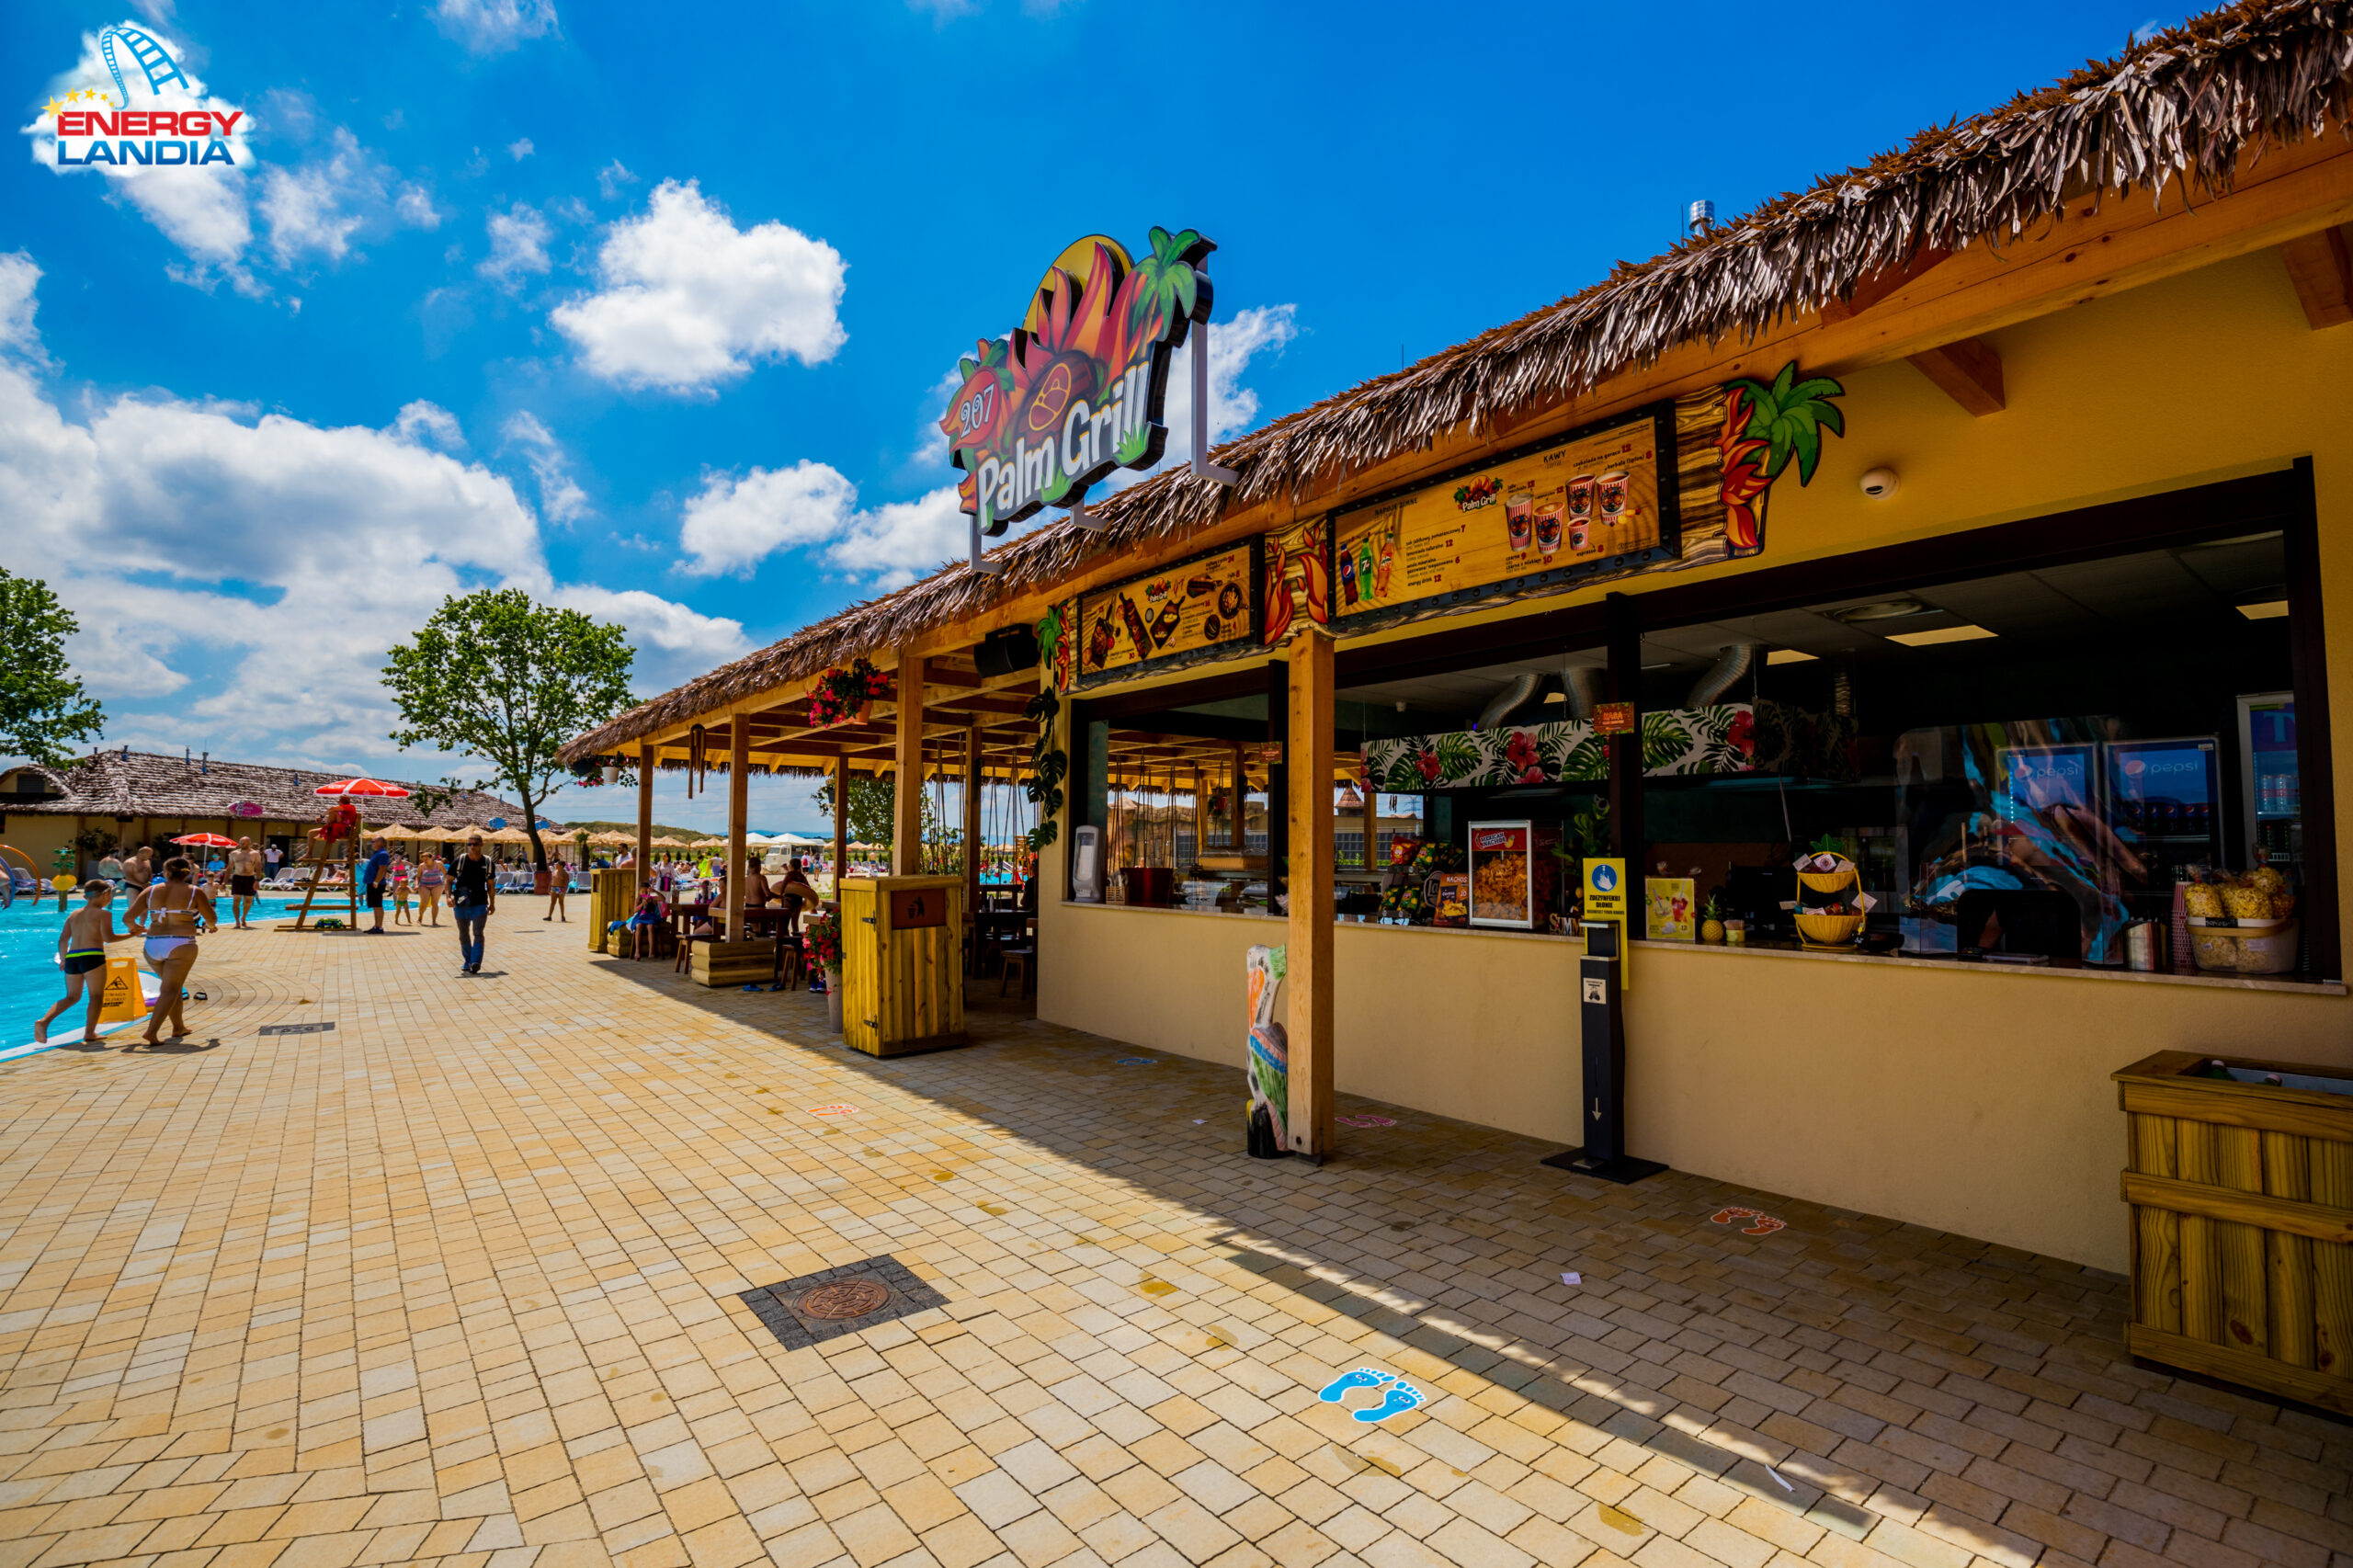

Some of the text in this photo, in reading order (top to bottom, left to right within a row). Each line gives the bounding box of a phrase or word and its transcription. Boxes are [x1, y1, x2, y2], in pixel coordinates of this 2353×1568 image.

[960, 382, 995, 437] 207
[976, 360, 1150, 529] Palm Grill
[1621, 443, 1631, 453] 12
[1543, 449, 1567, 464] KAWY
[1461, 492, 1496, 513] Palm Grill
[1446, 539, 1453, 548] 12
[1455, 555, 1461, 563] 6
[1521, 551, 1527, 560] 9
[1543, 555, 1553, 564] 10
[1434, 574, 1442, 583] 12
[2036, 766, 2079, 779] pepsi
[2151, 760, 2199, 776] pepsi
[1480, 832, 1504, 842] MEXICAN
[1549, 912, 1585, 936] SUMM
